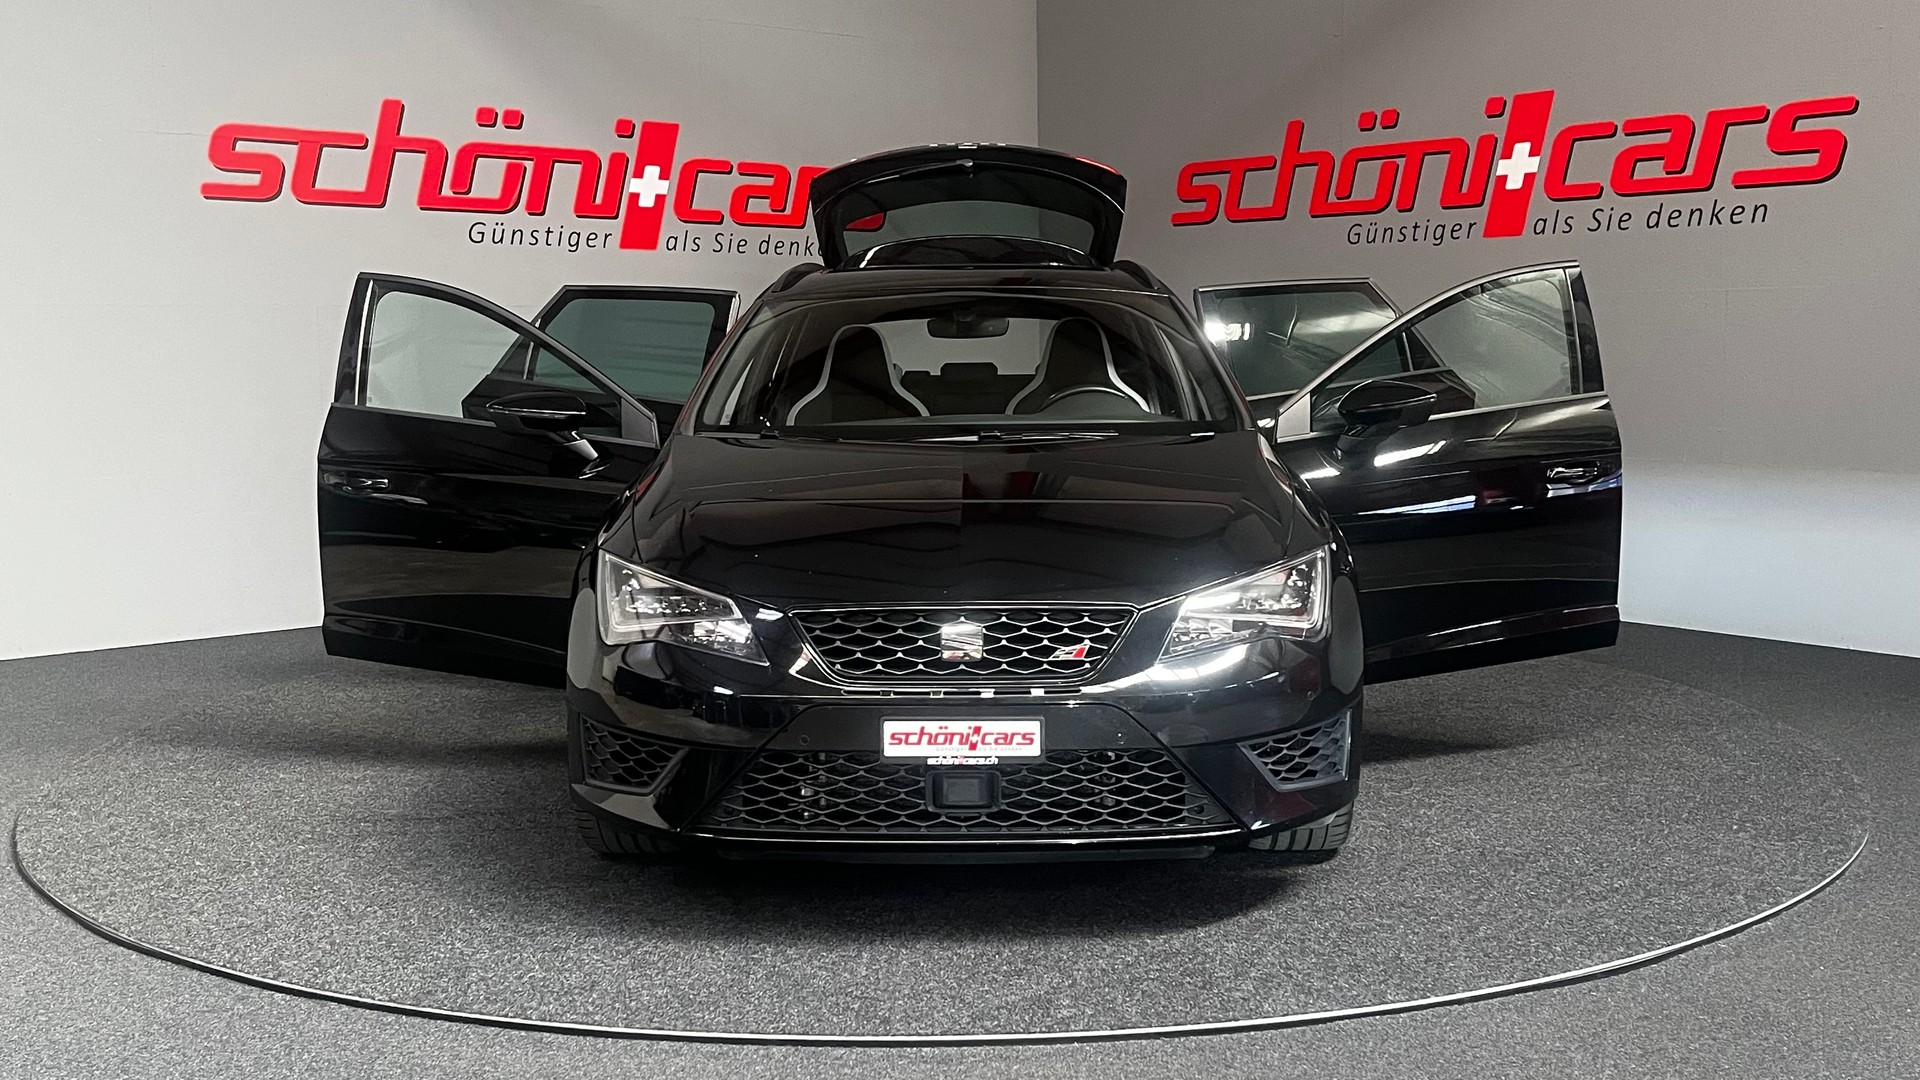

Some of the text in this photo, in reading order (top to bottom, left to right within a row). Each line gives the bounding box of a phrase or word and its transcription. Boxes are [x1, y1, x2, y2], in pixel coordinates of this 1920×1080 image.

[1543, 95, 1860, 201] cars
[668, 157, 886, 231] car
[468, 221, 613, 253] Günstiger
[665, 230, 702, 254] als
[712, 232, 749, 254] Sie
[1347, 201, 1769, 247] Günstiger als Sie denken
[980, 732, 1036, 746] cars
